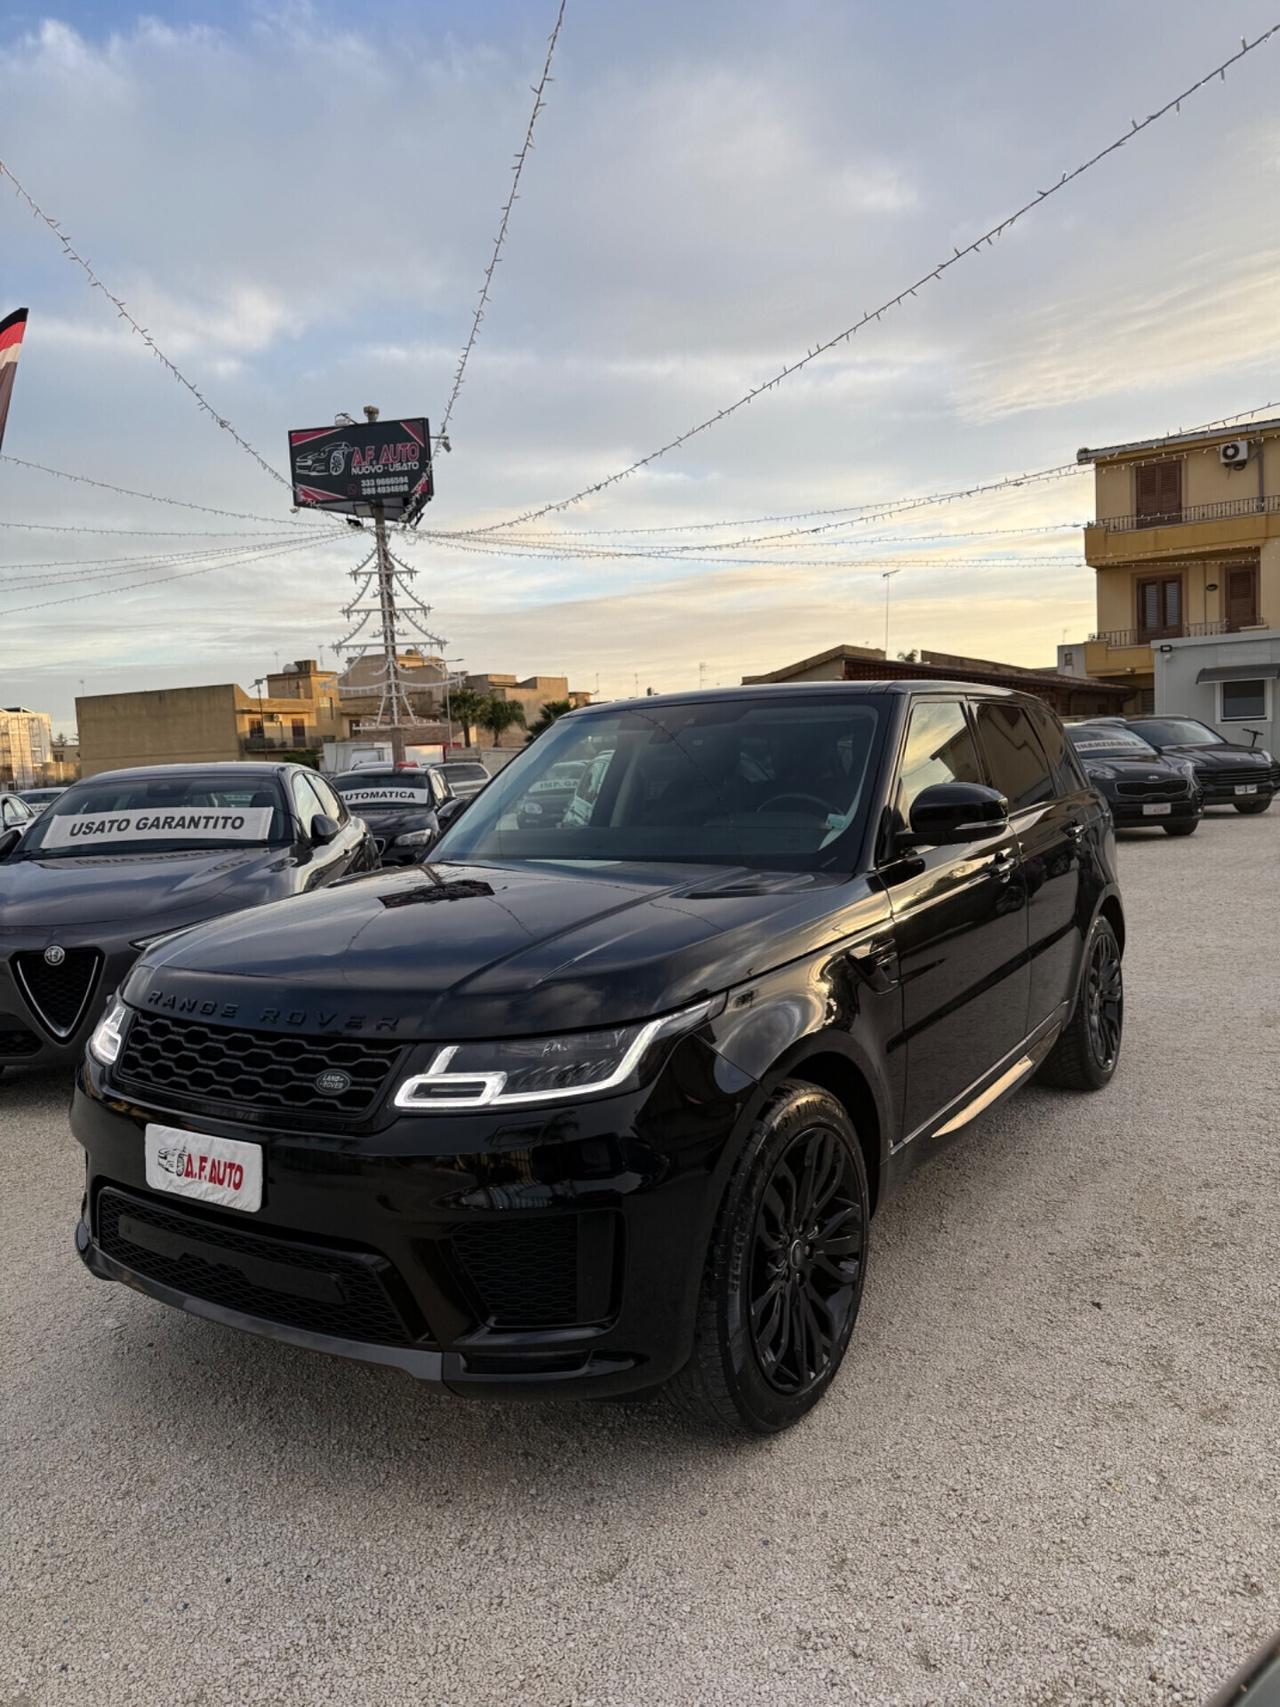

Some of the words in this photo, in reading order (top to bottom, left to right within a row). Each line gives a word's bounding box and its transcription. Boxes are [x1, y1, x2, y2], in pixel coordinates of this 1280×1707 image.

[379, 442, 419, 464] AUTO
[351, 465, 383, 475] NUOVO
[389, 461, 419, 472] USATO
[69, 818, 131, 837] USATO
[135, 816, 245, 831] GARANTITO
[148, 991, 240, 1018] RANGE
[259, 1007, 400, 1032] ROVER
[184, 1153, 207, 1180] A.F.
[208, 1158, 244, 1191] AUTO
